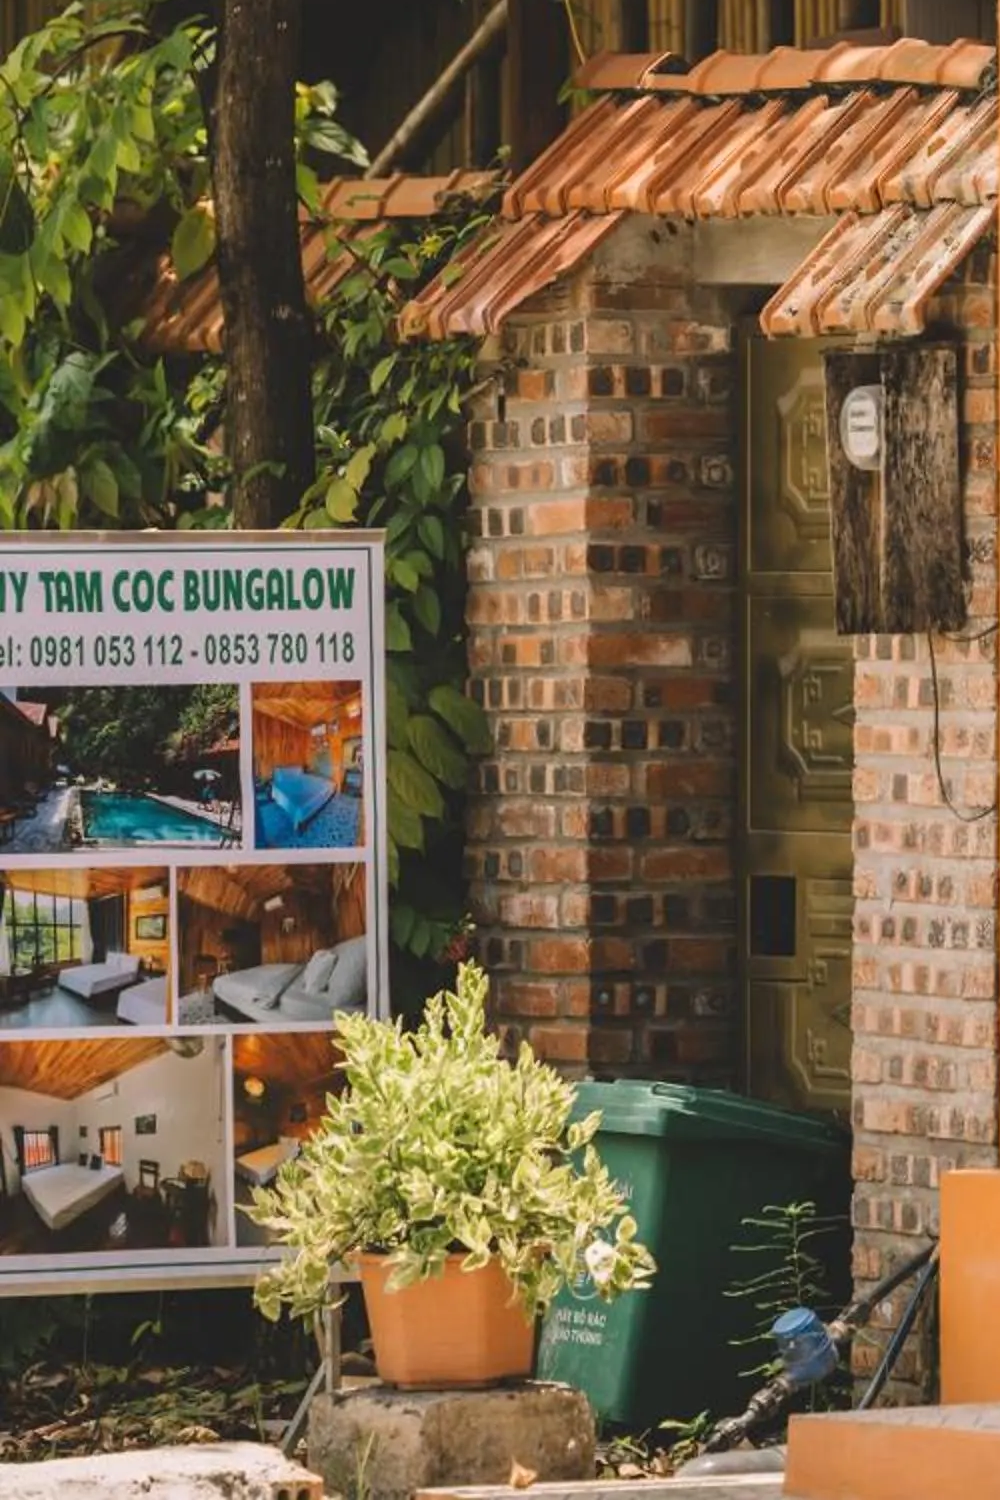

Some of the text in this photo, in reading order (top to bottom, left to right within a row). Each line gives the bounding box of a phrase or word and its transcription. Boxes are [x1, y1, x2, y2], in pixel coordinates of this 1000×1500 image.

[38, 570, 103, 613] TAM
[112, 569, 175, 613] COC
[183, 567, 356, 612] BUNGALOW
[30, 635, 84, 667] 0981
[94, 634, 136, 667] 053
[143, 634, 184, 666] 112
[204, 633, 260, 665] 0853
[266, 631, 308, 664] 780
[315, 630, 355, 664] 118
